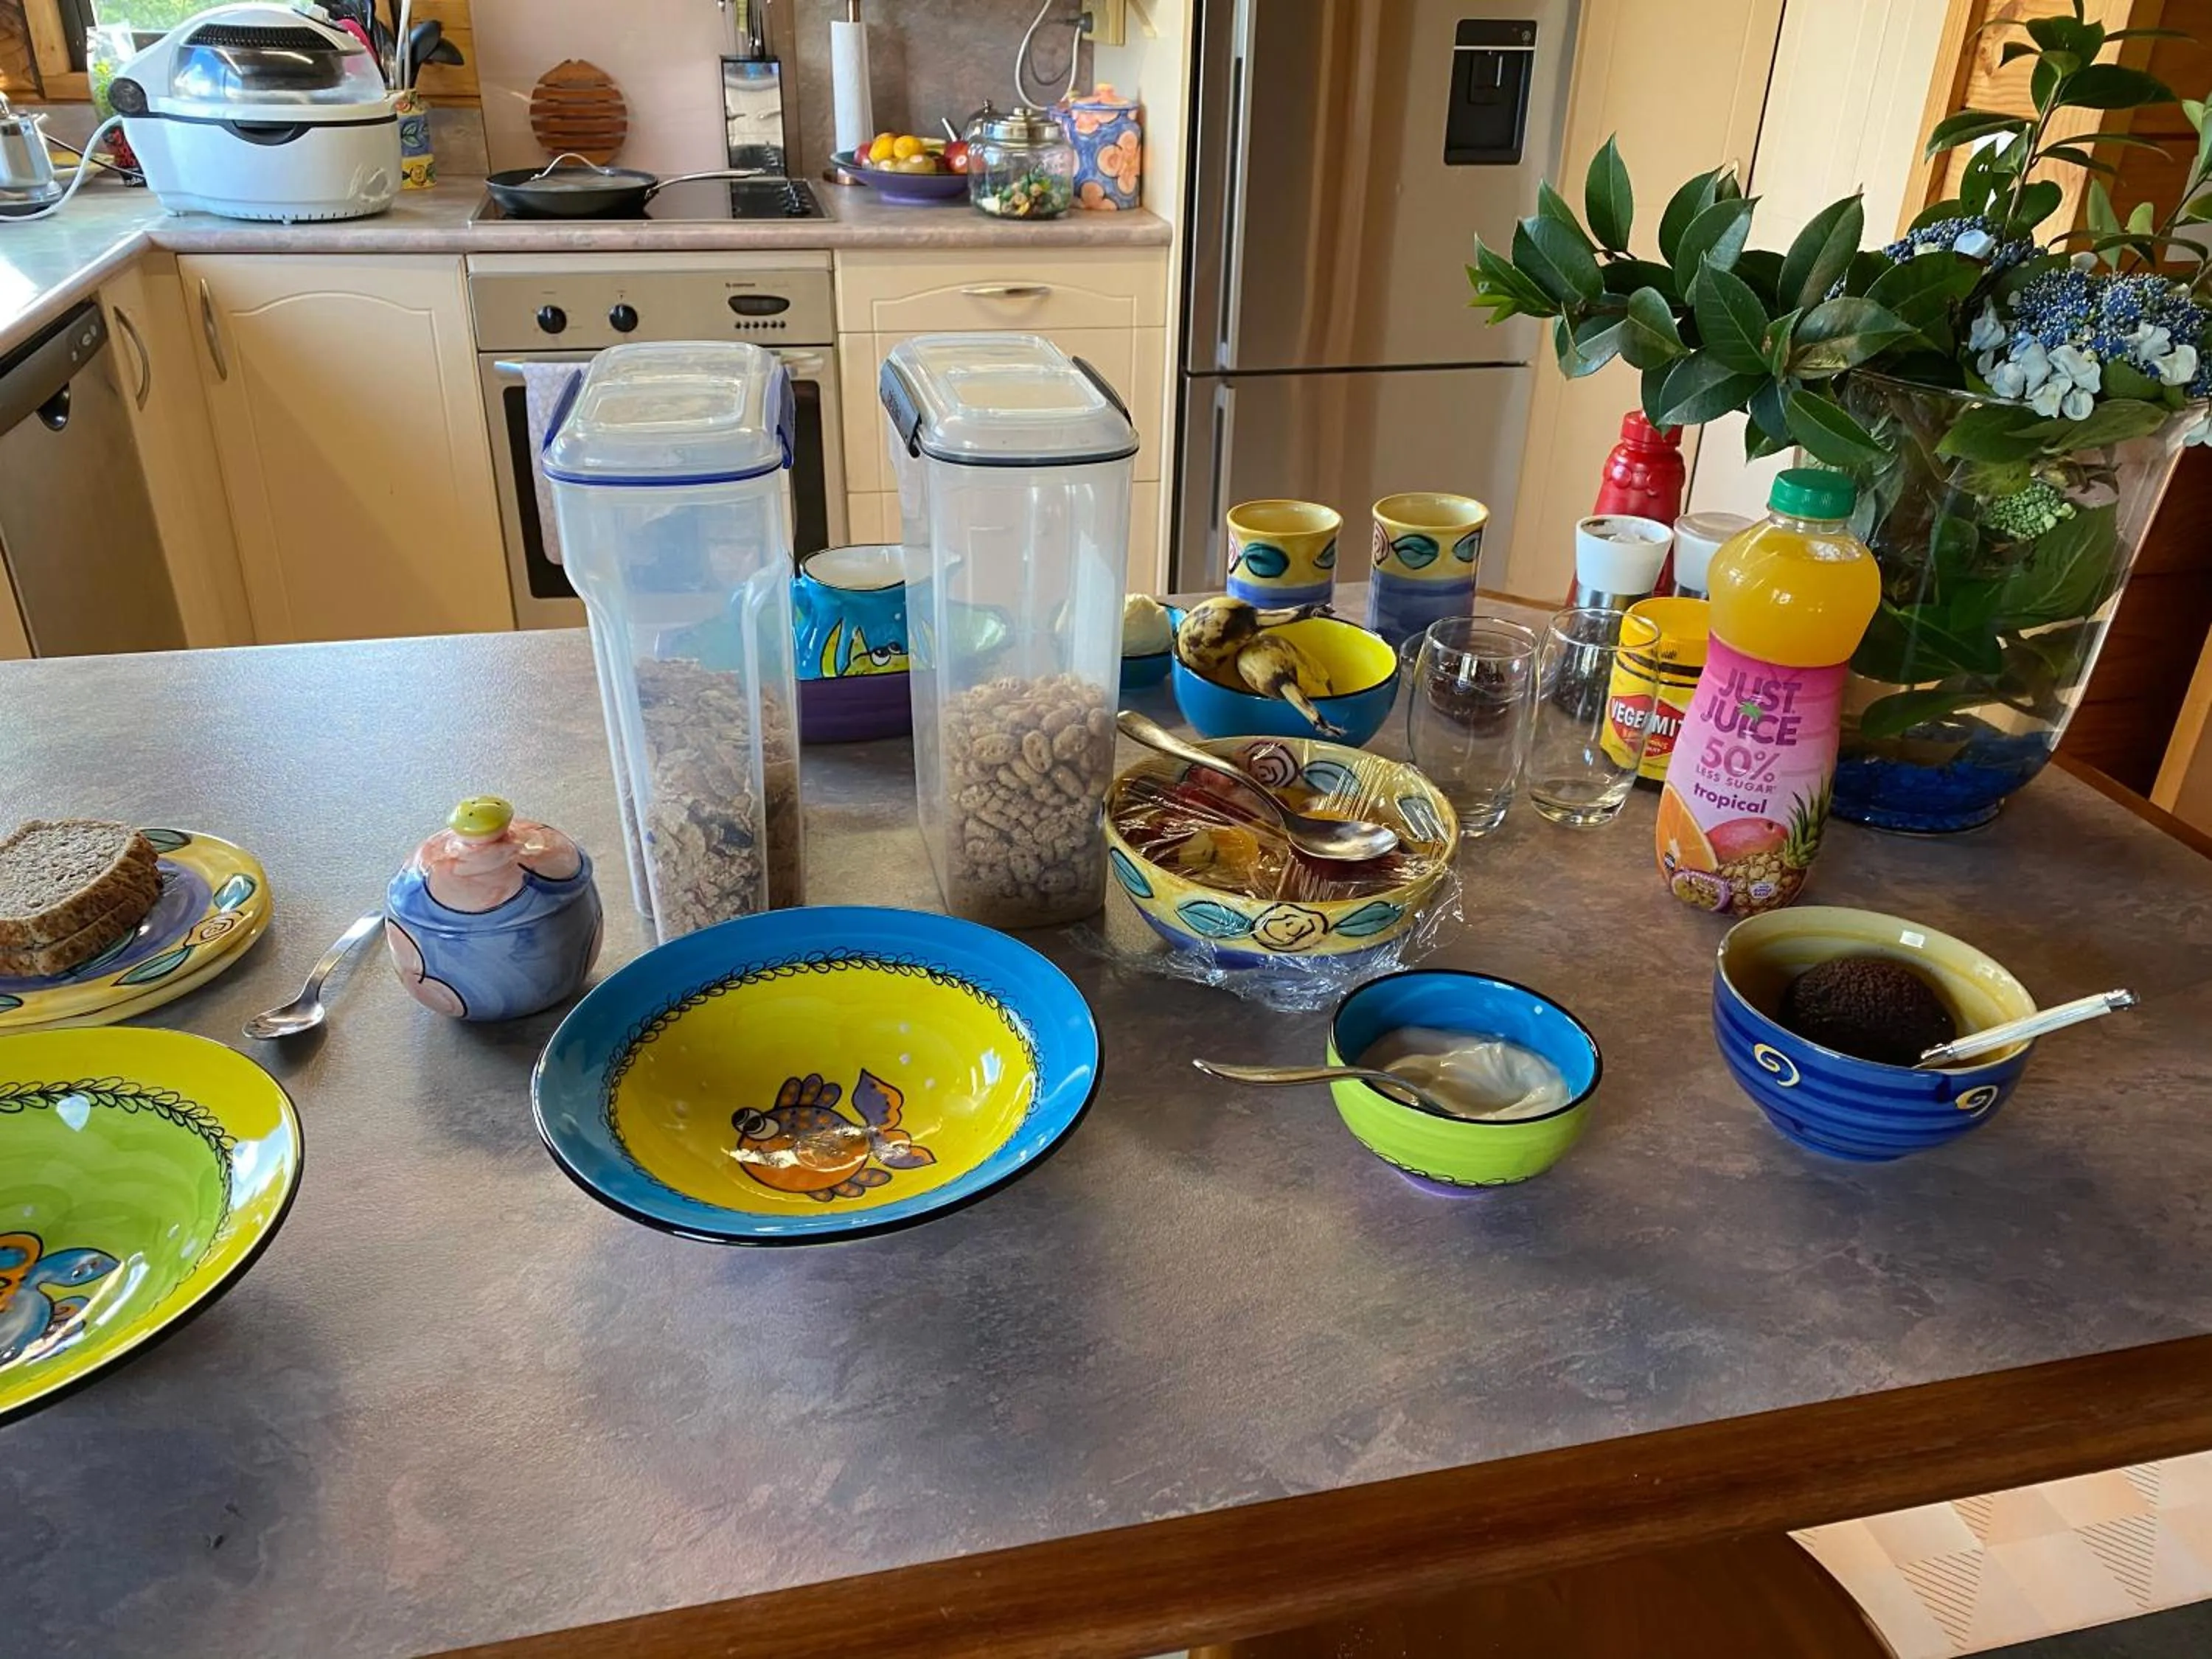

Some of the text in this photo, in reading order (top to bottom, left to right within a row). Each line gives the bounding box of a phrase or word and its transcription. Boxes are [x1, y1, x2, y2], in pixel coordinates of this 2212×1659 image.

[1718, 667, 1803, 714] JUST
[1700, 695, 1803, 746] JUICE
[1696, 763, 1721, 782] LESS
[1700, 736, 1781, 783] 50%
[1694, 782, 1767, 814] tropical
